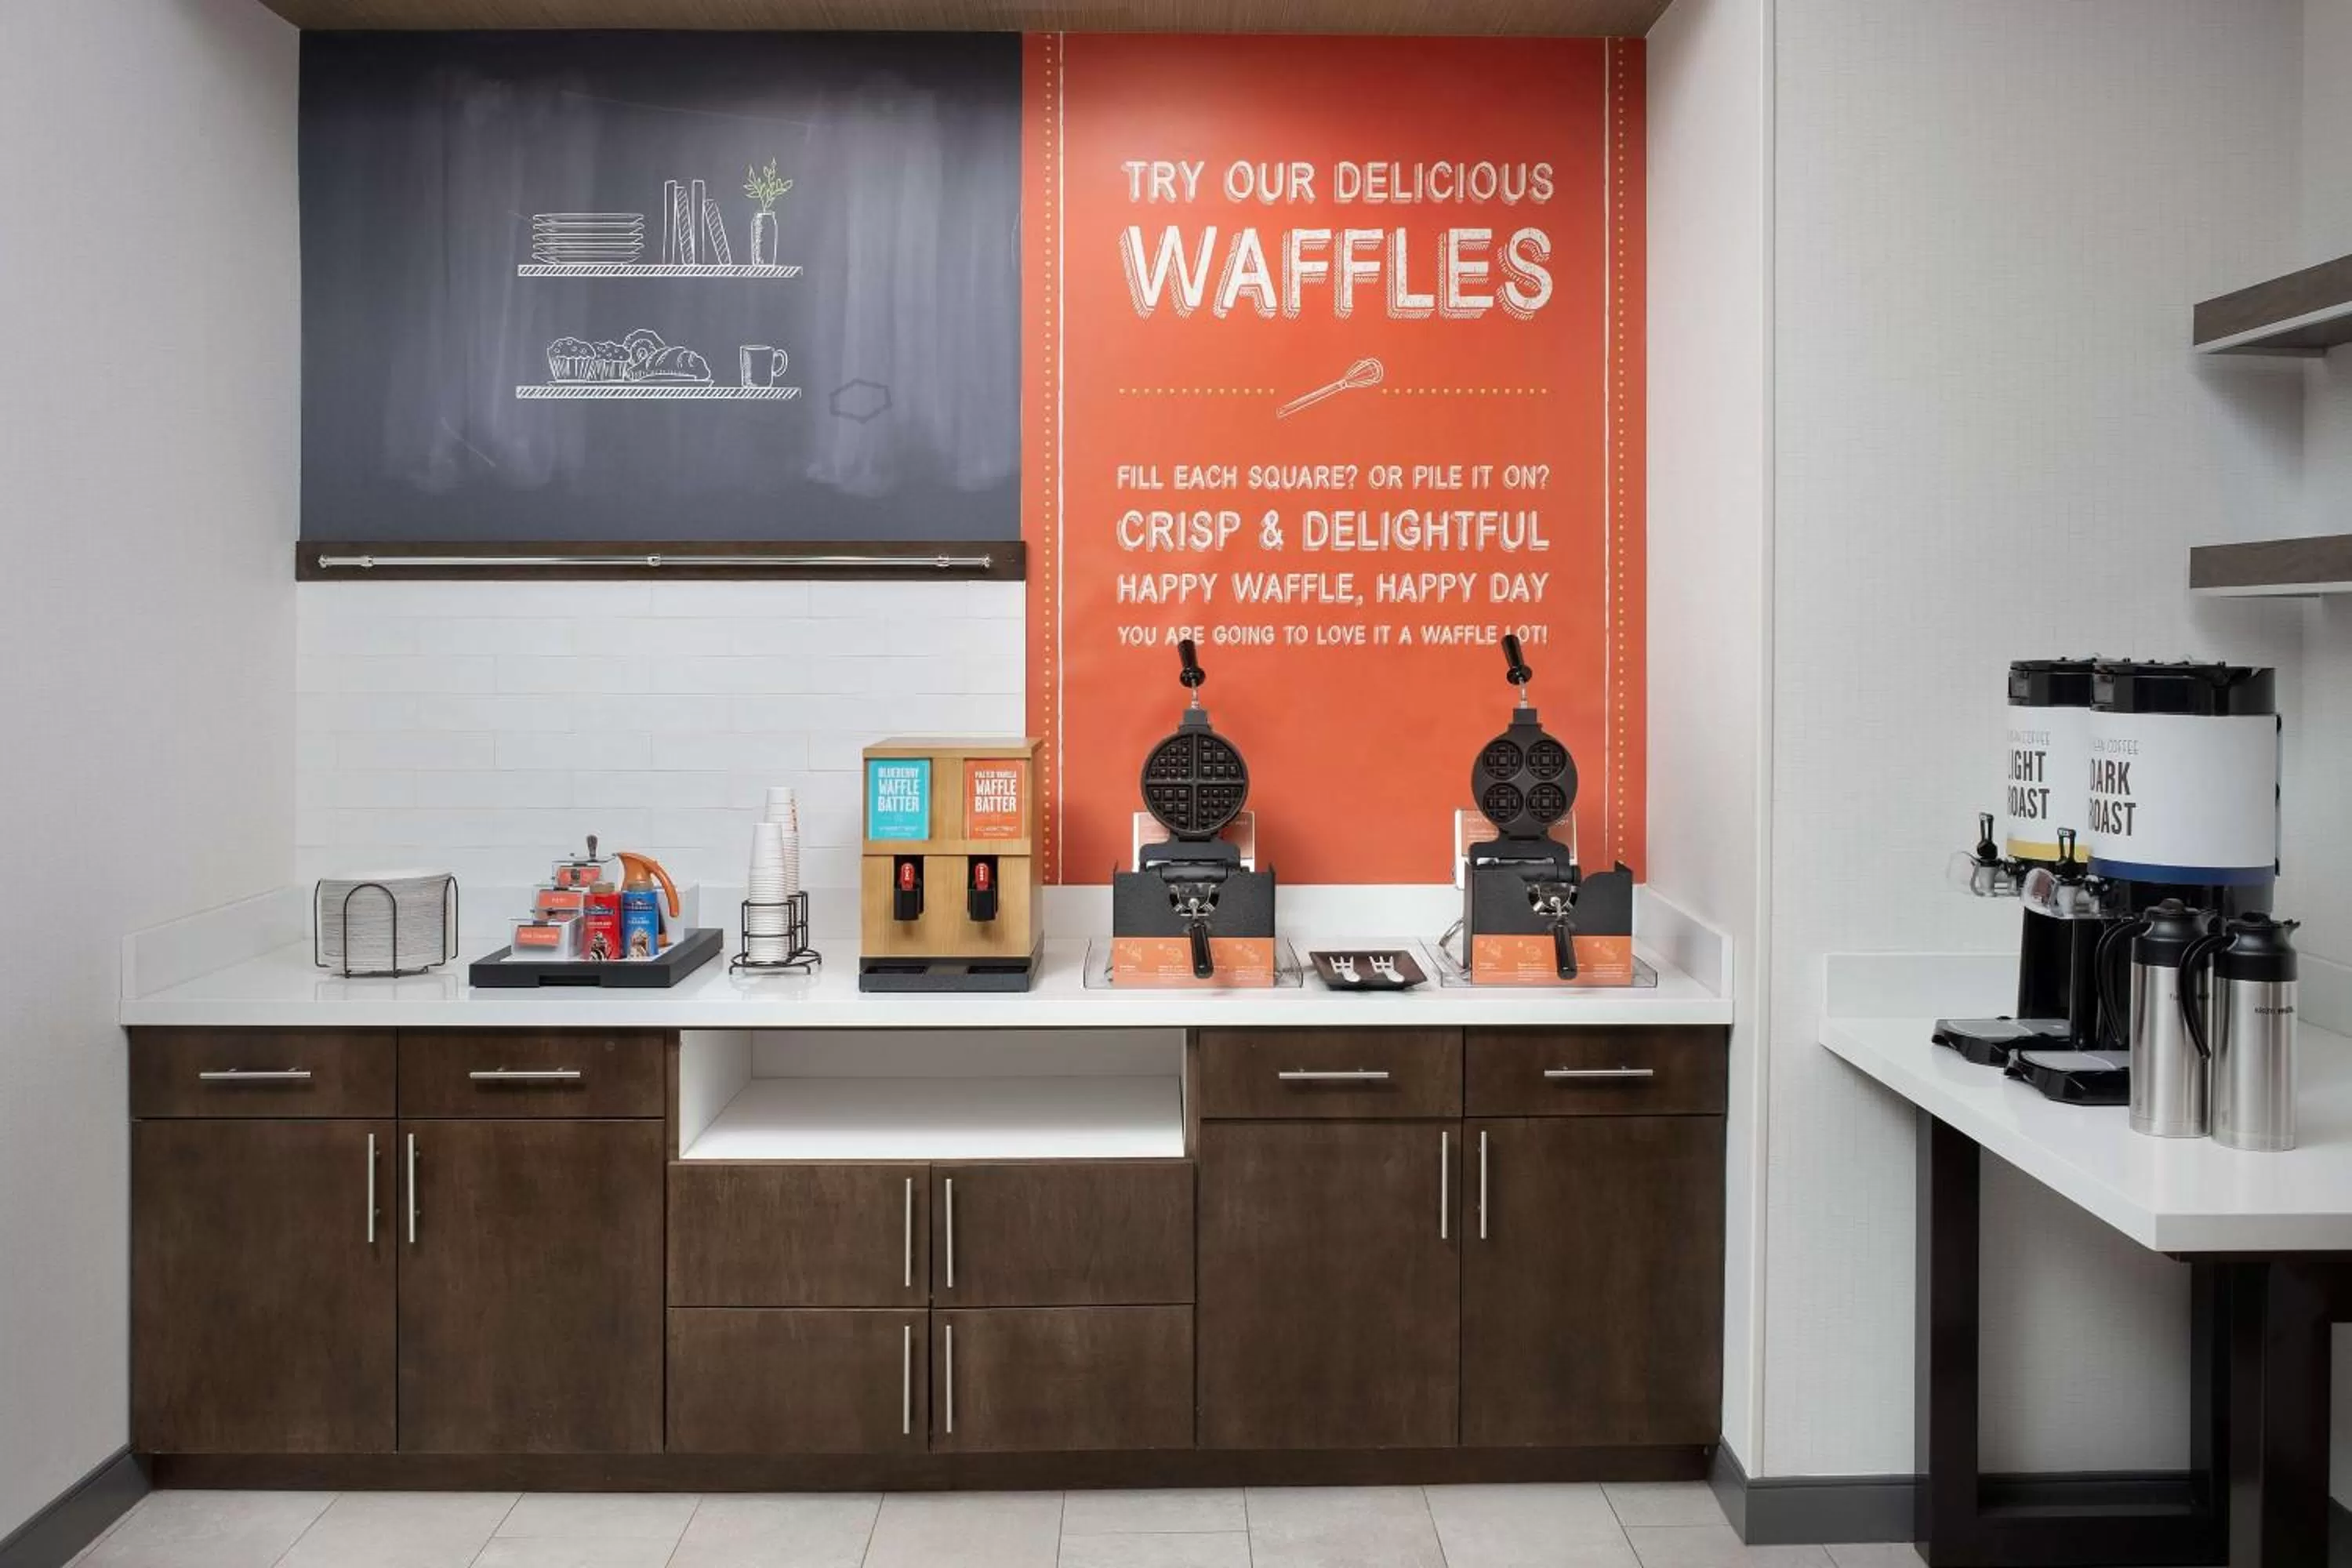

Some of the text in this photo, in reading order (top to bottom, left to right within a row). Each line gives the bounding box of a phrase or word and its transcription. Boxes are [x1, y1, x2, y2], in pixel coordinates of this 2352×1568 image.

[1121, 161, 1554, 205] TRY OUR DELICIOUS
[1119, 226, 1553, 319] WAFFLES
[1116, 464, 1550, 490] FILL EACH SQUARE? OR PILE IT ON?
[1116, 509, 1550, 552] CRISP & DELIGHTFUL
[1116, 572, 1549, 606] HAPPY WAFFLE, HAPPY DAY
[1118, 625, 1158, 646] YOU
[1164, 625, 1205, 646] ARE
[1212, 625, 1275, 645] GOING
[1283, 625, 1308, 645] TO
[1317, 625, 1366, 645] LOVE
[1374, 625, 1392, 644] IT
[1399, 625, 1412, 644] A
[1421, 625, 1497, 644] WAFFLE
[878, 779, 920, 795] WAFFLE
[975, 779, 1017, 796] WAFFLE
[2089, 757, 2132, 796] DARK
[877, 796, 920, 812] BATTER
[975, 796, 1017, 813] BATTER
